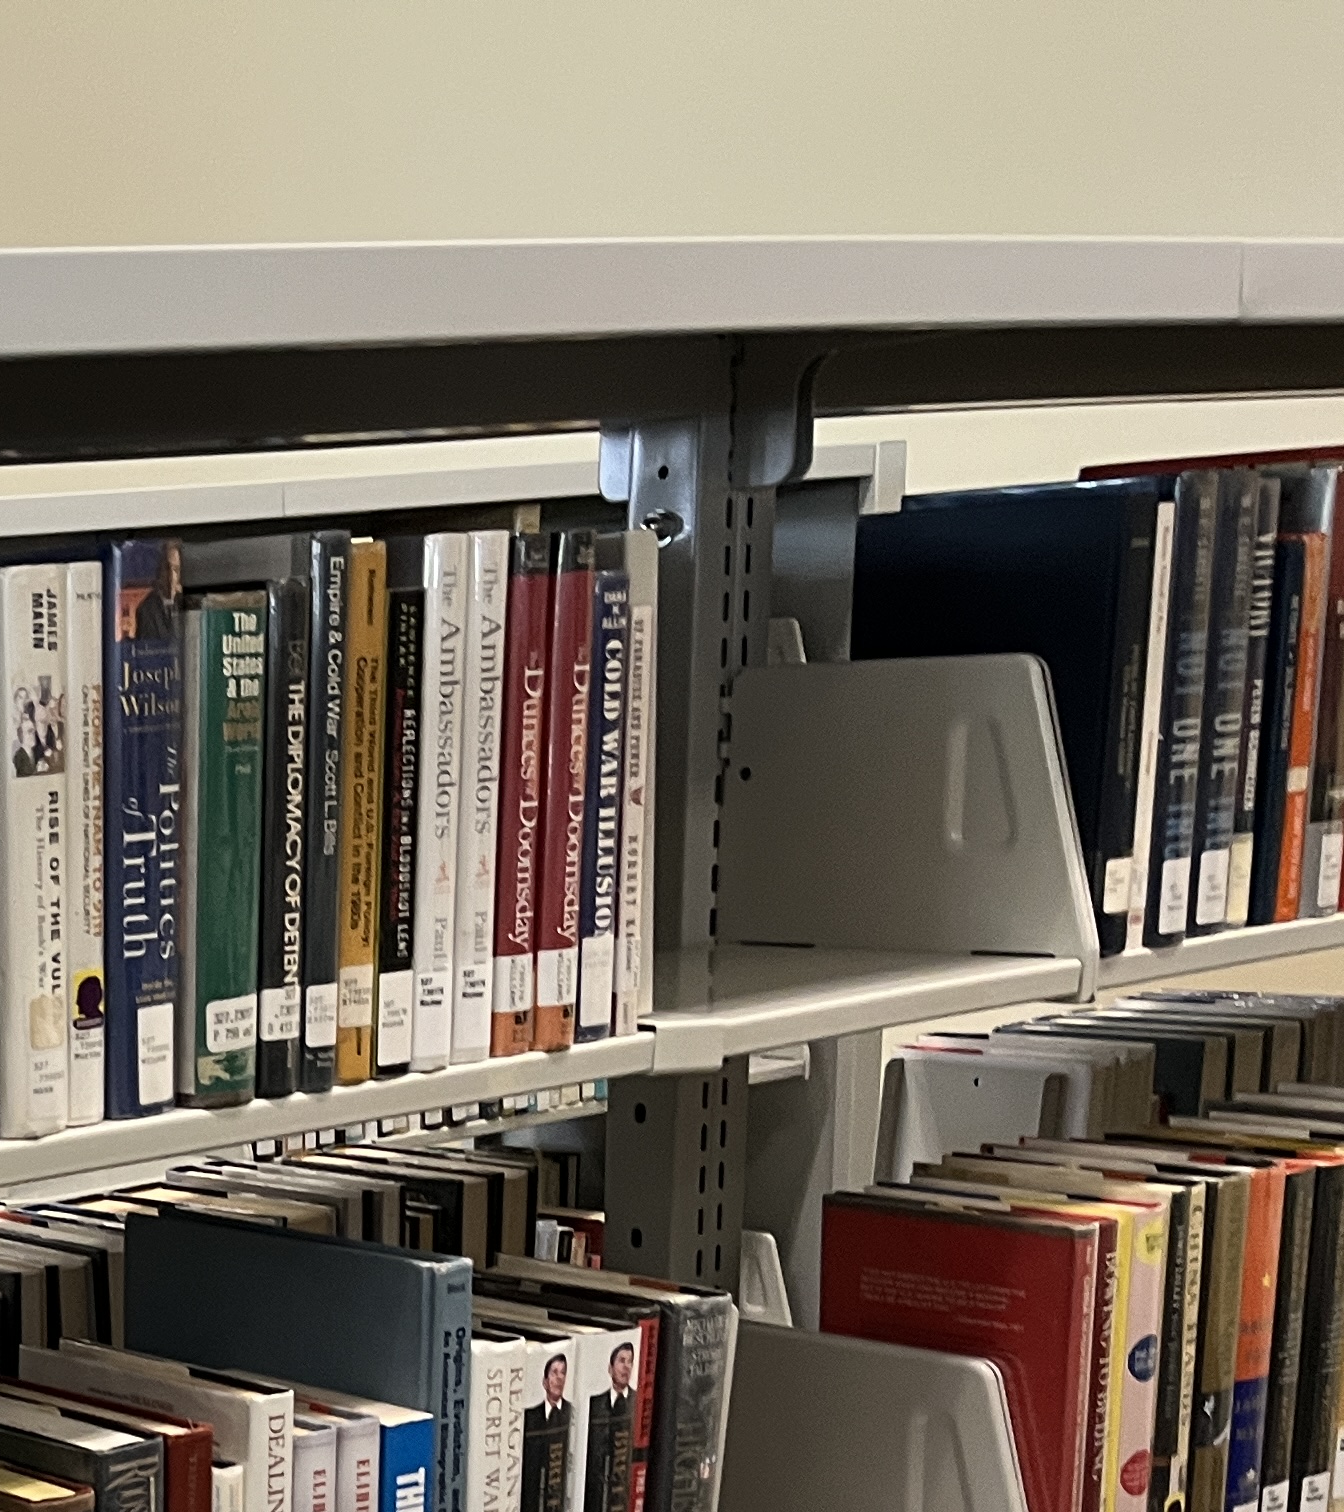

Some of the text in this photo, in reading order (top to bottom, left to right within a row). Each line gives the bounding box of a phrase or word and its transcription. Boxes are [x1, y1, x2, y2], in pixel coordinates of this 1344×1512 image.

[30, 592, 45, 649] MANN
[45, 589, 58, 651] JAMES
[324, 556, 344, 738] Empire & Cold War
[432, 565, 461, 840] The Ambassadors
[473, 565, 503, 835] The Ambassadors
[598, 638, 623, 798] COLD WAR
[1168, 715, 1201, 786] ONE
[1210, 710, 1242, 781] ONE
[47, 791, 62, 940] RISE OF THE
[283, 680, 304, 909] THE DIPLOMACY OF
[554, 791, 585, 941] Doomsday
[117, 796, 161, 959] of Truth
[152, 782, 181, 960] Politics
[507, 796, 538, 946] Doomsday
[480, 1367, 507, 1460] SECRET
